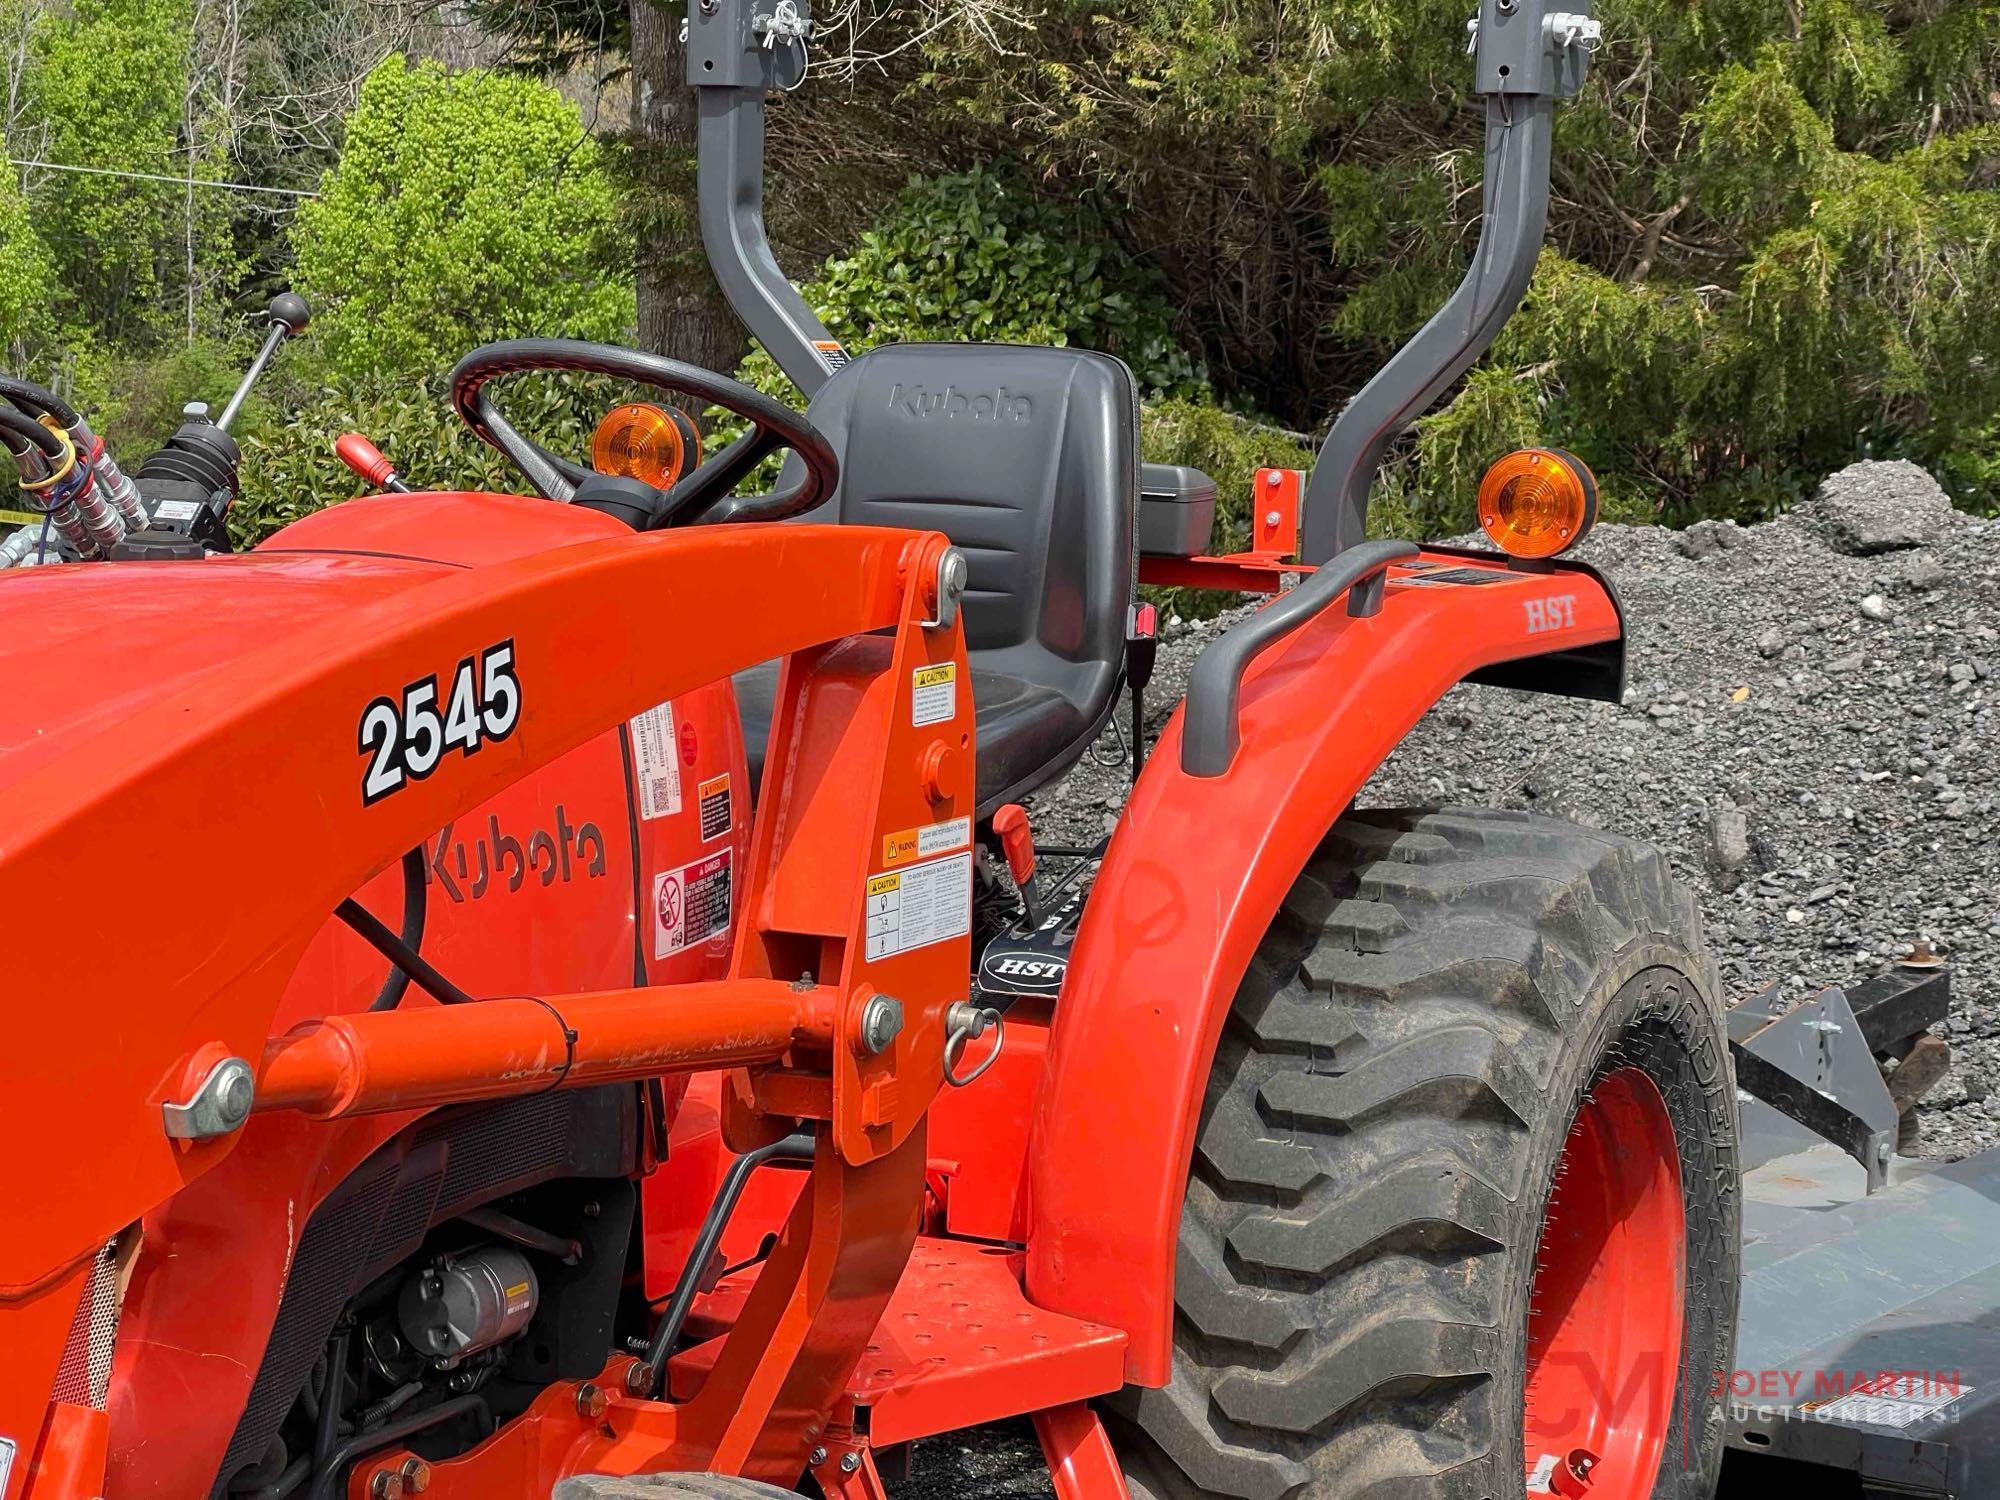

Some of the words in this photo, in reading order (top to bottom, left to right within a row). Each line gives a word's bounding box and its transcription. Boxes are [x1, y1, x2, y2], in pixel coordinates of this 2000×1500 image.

[889, 383, 1033, 421] Kubota
[1524, 594, 1576, 634] HST
[926, 669, 949, 683] CAUTION
[360, 641, 520, 803] 2545
[422, 804, 606, 902] Kubota
[704, 858, 720, 873] DANGER
[878, 878, 896, 890] CAUTION
[995, 958, 1066, 978] HST
